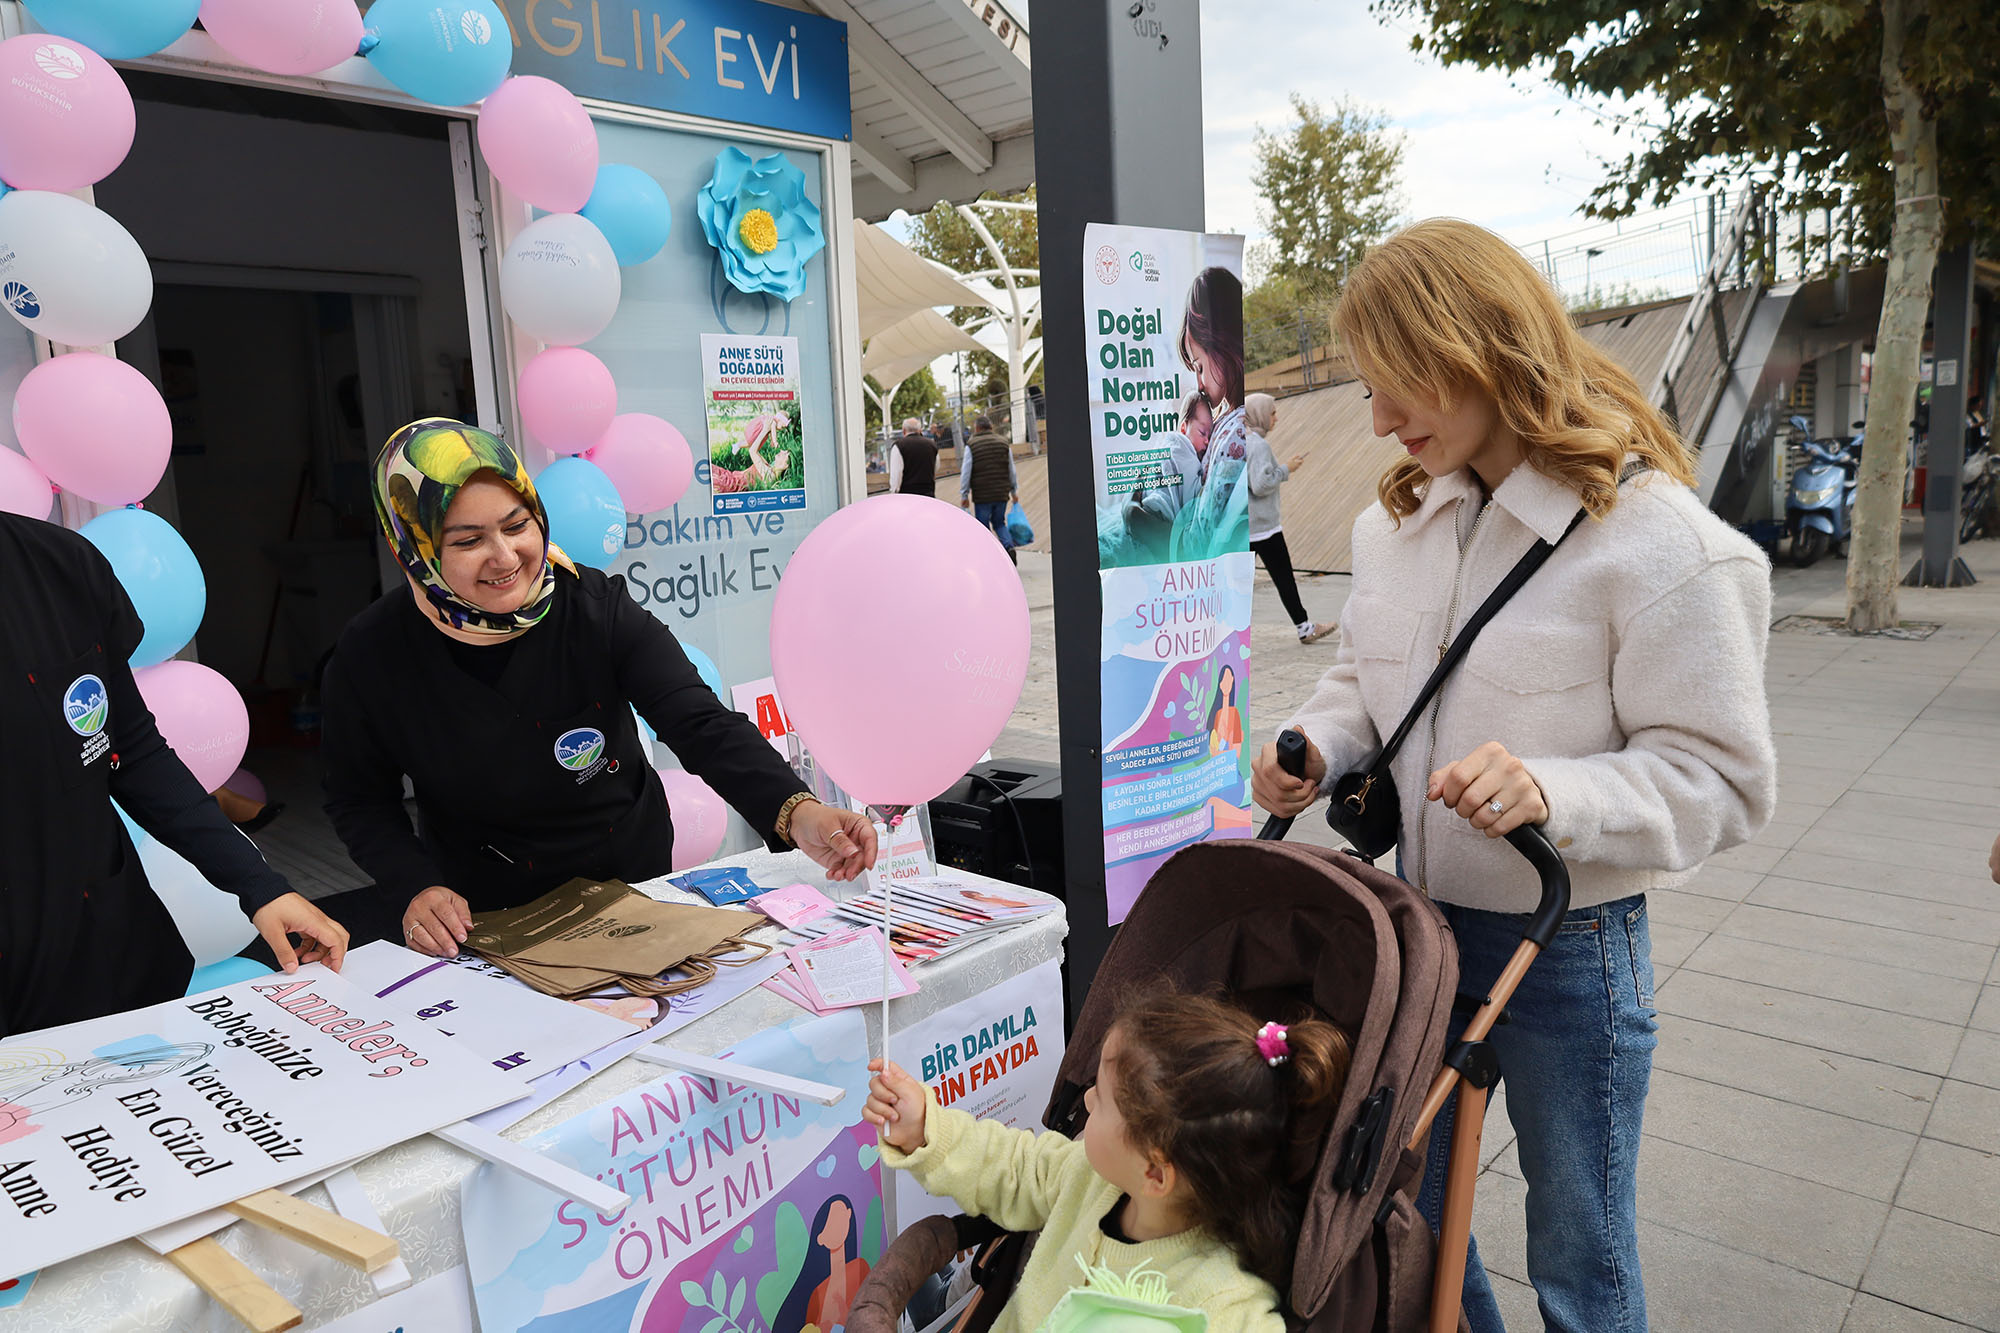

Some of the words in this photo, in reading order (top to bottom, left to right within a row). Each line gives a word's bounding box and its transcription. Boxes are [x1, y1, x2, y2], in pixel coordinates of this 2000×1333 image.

[1097, 308, 1162, 342] Doğal
[719, 347, 752, 361] ANNE
[754, 345, 783, 361] SÜTÜ
[1100, 343, 1154, 369] Olan
[719, 360, 784, 375] DOĞADAKİ
[720, 376, 730, 384] EN
[731, 376, 757, 384] ÇEVRECİ
[757, 376, 785, 385] BESİNDİR
[1102, 373, 1180, 403] Normal
[1104, 408, 1179, 441] Doğum
[1127, 452, 1149, 463] olarak
[1150, 449, 1170, 460] zorunlu
[1108, 466, 1140, 479] olmadığı
[1142, 465, 1161, 475] sürece
[1108, 482, 1143, 493] sezaryen
[1144, 476, 1161, 489] doğal
[1161, 475, 1183, 487] değildir.
[744, 512, 785, 536] ve
[627, 553, 739, 618] Sağlık
[1162, 563, 1215, 593] ANNE
[1135, 590, 1222, 629] SÜTÜNÜN
[1155, 623, 1215, 659] ÖNEMİ
[1105, 753, 1128, 763] SEVGİLİ
[1129, 747, 1161, 759] ANNELER,
[1162, 739, 1194, 752] BEBEĞİNİZE
[1121, 760, 1146, 770] SADECE
[1147, 756, 1166, 766] ANNE
[1166, 750, 1182, 761] SÜTÜ
[1107, 793, 1153, 811] BESİNLERLE
[1154, 785, 1185, 800] BİRLİKTE
[1147, 778, 1172, 791] SONRA
[1135, 804, 1161, 817] KADAR
[1116, 831, 1132, 844] HER
[1133, 826, 1160, 840] BEBEK
[1118, 843, 1142, 855] KENDİ
[185, 995, 324, 1081] Bebeğinize
[921, 1043, 959, 1082] BİR
[961, 1006, 1037, 1061] DAMLA
[969, 1035, 1039, 1092] FAYDA
[179, 1062, 304, 1163] Vereceğiniz
[116, 1087, 162, 1118] En
[149, 1115, 234, 1178] Güzel
[61, 1124, 147, 1203] Hediye
[0, 1159, 57, 1218] Anne
[614, 1143, 774, 1279] ÖNEMİ
